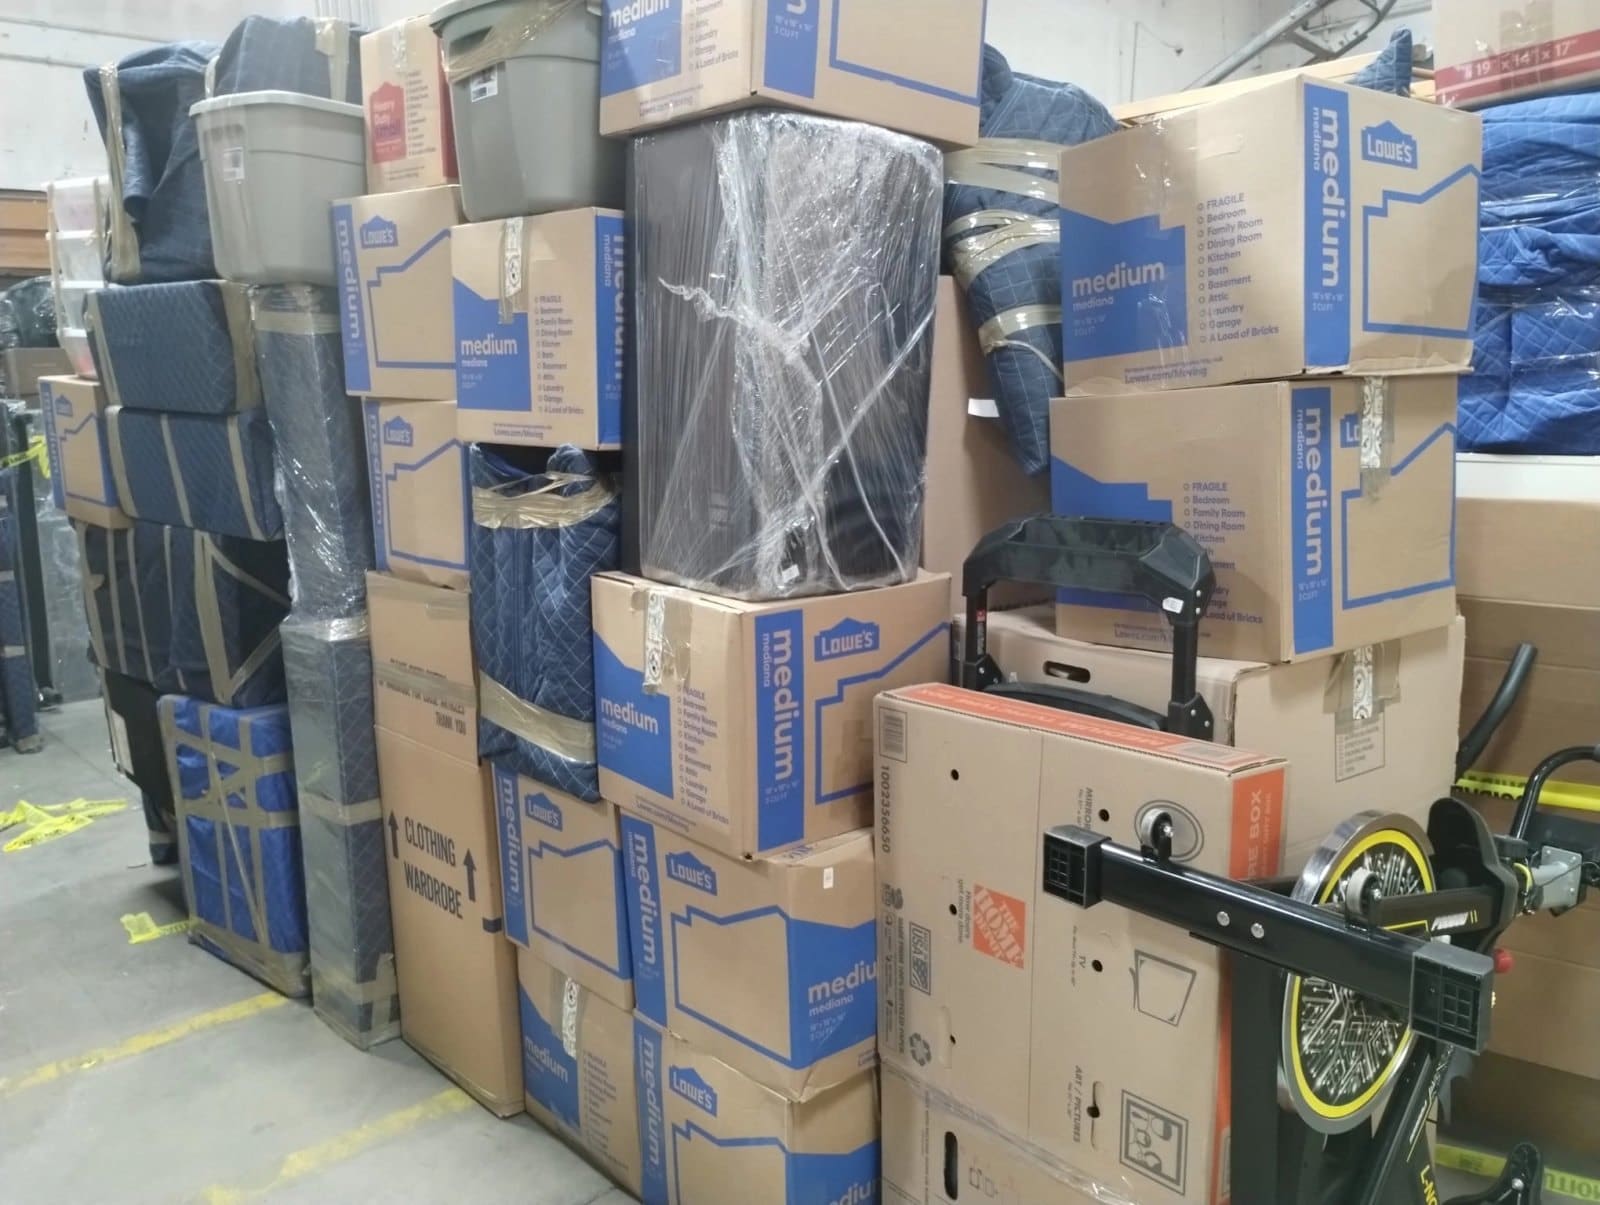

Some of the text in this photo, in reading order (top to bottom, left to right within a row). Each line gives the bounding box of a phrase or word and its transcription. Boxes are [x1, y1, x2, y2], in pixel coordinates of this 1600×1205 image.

[1313, 107, 1321, 172] mediana
[1366, 133, 1413, 164] LOWE'S
[1207, 192, 1245, 209] FRAGILE
[1321, 108, 1346, 287] medium
[1207, 208, 1247, 223] Bedroom
[1207, 218, 1264, 237] Family Room
[362, 227, 395, 246] LOWE'S
[1207, 231, 1263, 250] Dining Room
[1207, 250, 1242, 263] Kitchen
[1208, 266, 1229, 276] Bath
[337, 219, 361, 339] medium
[1072, 260, 1166, 297] medium
[1208, 275, 1252, 290] Basement
[1072, 296, 1114, 312] mediana
[1208, 292, 1229, 302] Attic
[461, 333, 519, 356] medium
[1217, 331, 1240, 341] Load
[1240, 328, 1249, 338] of
[1250, 325, 1280, 337] Bricks
[1296, 409, 1305, 470] mediana
[1192, 482, 1228, 491] FRAGILE
[1192, 495, 1230, 505] Bedroom
[1305, 407, 1328, 576] medium
[1192, 508, 1246, 518] Family Room
[1193, 521, 1246, 532] Dining Room
[1235, 611, 1263, 624] Bricks
[821, 630, 874, 657] LOWE'S
[763, 633, 771, 688] mediana
[601, 697, 659, 735] medium
[773, 628, 800, 781] medium
[527, 799, 560, 827] LOWE'S
[1248, 788, 1262, 839] BOX
[404, 816, 457, 868] CLOTHING
[502, 778, 521, 893] medium
[403, 860, 464, 920] WARDROBE
[670, 860, 713, 891] LOWE'S
[634, 832, 659, 966] medium
[975, 888, 1024, 961] HOME
[911, 927, 924, 956] USA
[1078, 955, 1086, 969] TV
[807, 960, 878, 1005] mediu
[808, 993, 855, 1018] mediana
[524, 1035, 568, 1083] medium
[672, 1071, 714, 1110] LOWE'S
[1074, 1065, 1083, 1088] ART
[643, 1036, 661, 1166] medium
[1073, 1096, 1082, 1143] PICTURES
